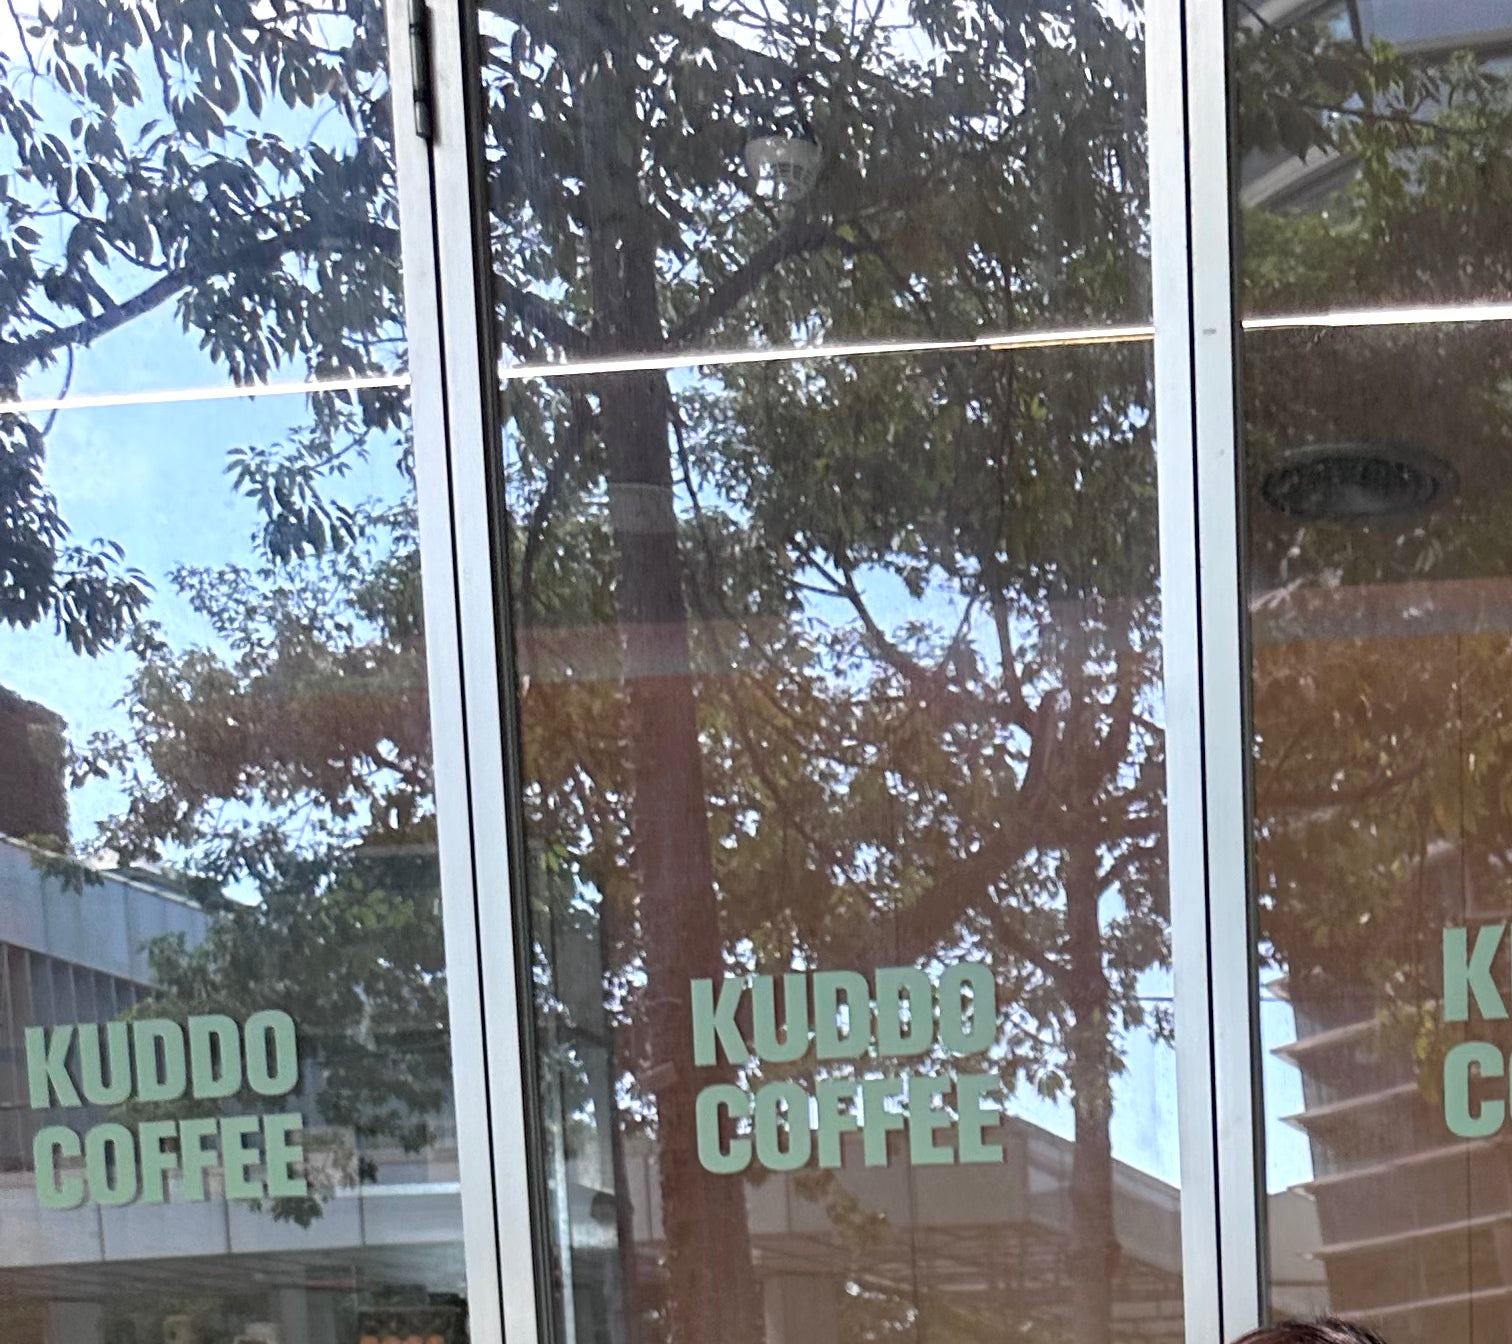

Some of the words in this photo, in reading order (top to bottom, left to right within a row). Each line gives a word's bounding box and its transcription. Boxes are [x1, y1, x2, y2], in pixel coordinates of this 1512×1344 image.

[26, 1010, 299, 1107] KUDDO
[690, 961, 996, 1066] KUDDO
[34, 1112, 307, 1208] COFFEE
[695, 1073, 1003, 1175] COFFEE
